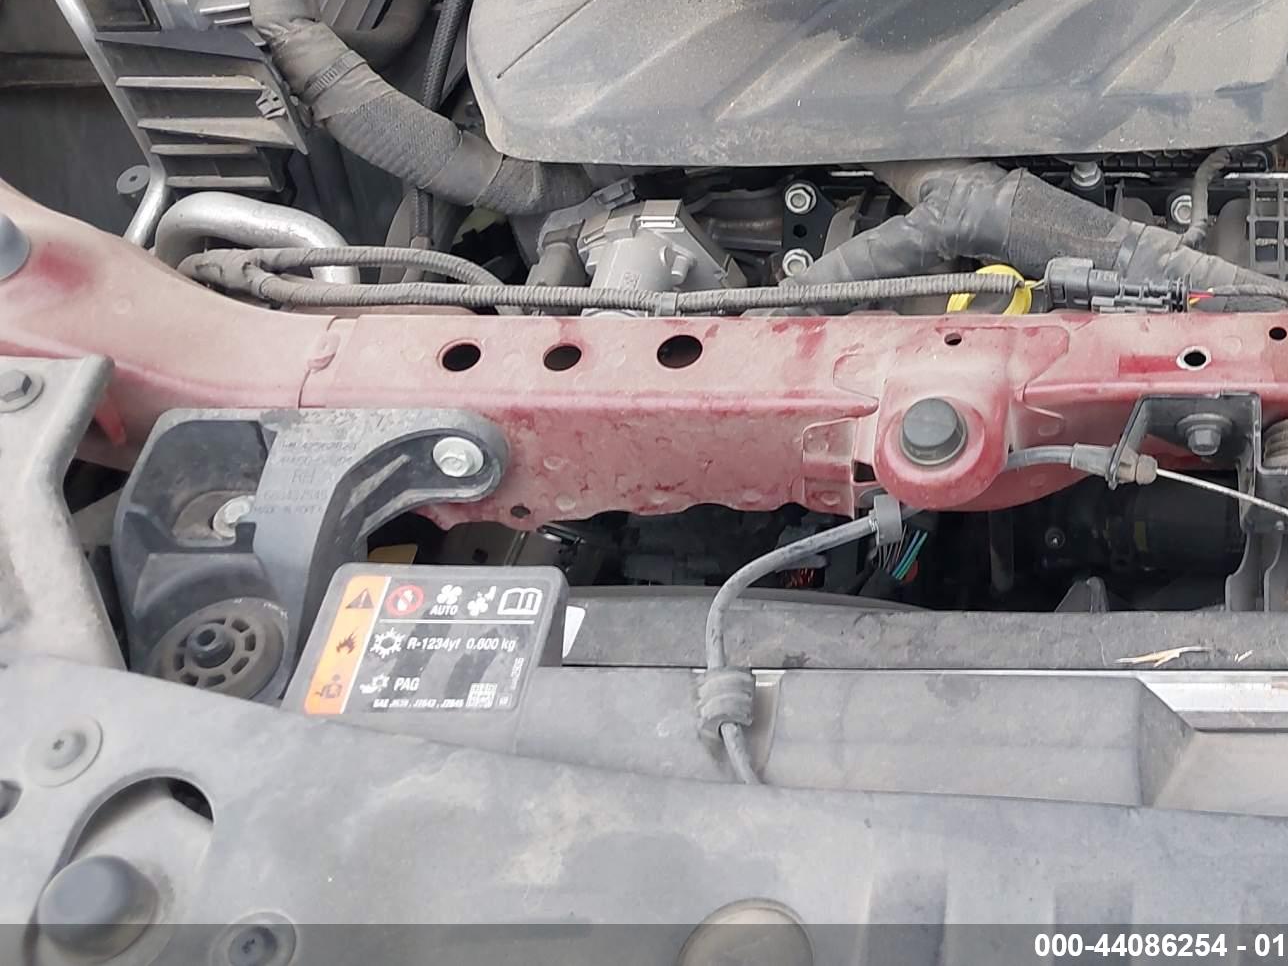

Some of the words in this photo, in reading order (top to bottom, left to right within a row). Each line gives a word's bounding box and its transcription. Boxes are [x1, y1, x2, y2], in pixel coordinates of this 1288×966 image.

[429, 605, 459, 616] AUTO
[406, 637, 462, 652] R-1234yf
[501, 636, 517, 653] kg
[393, 677, 421, 691] PAG
